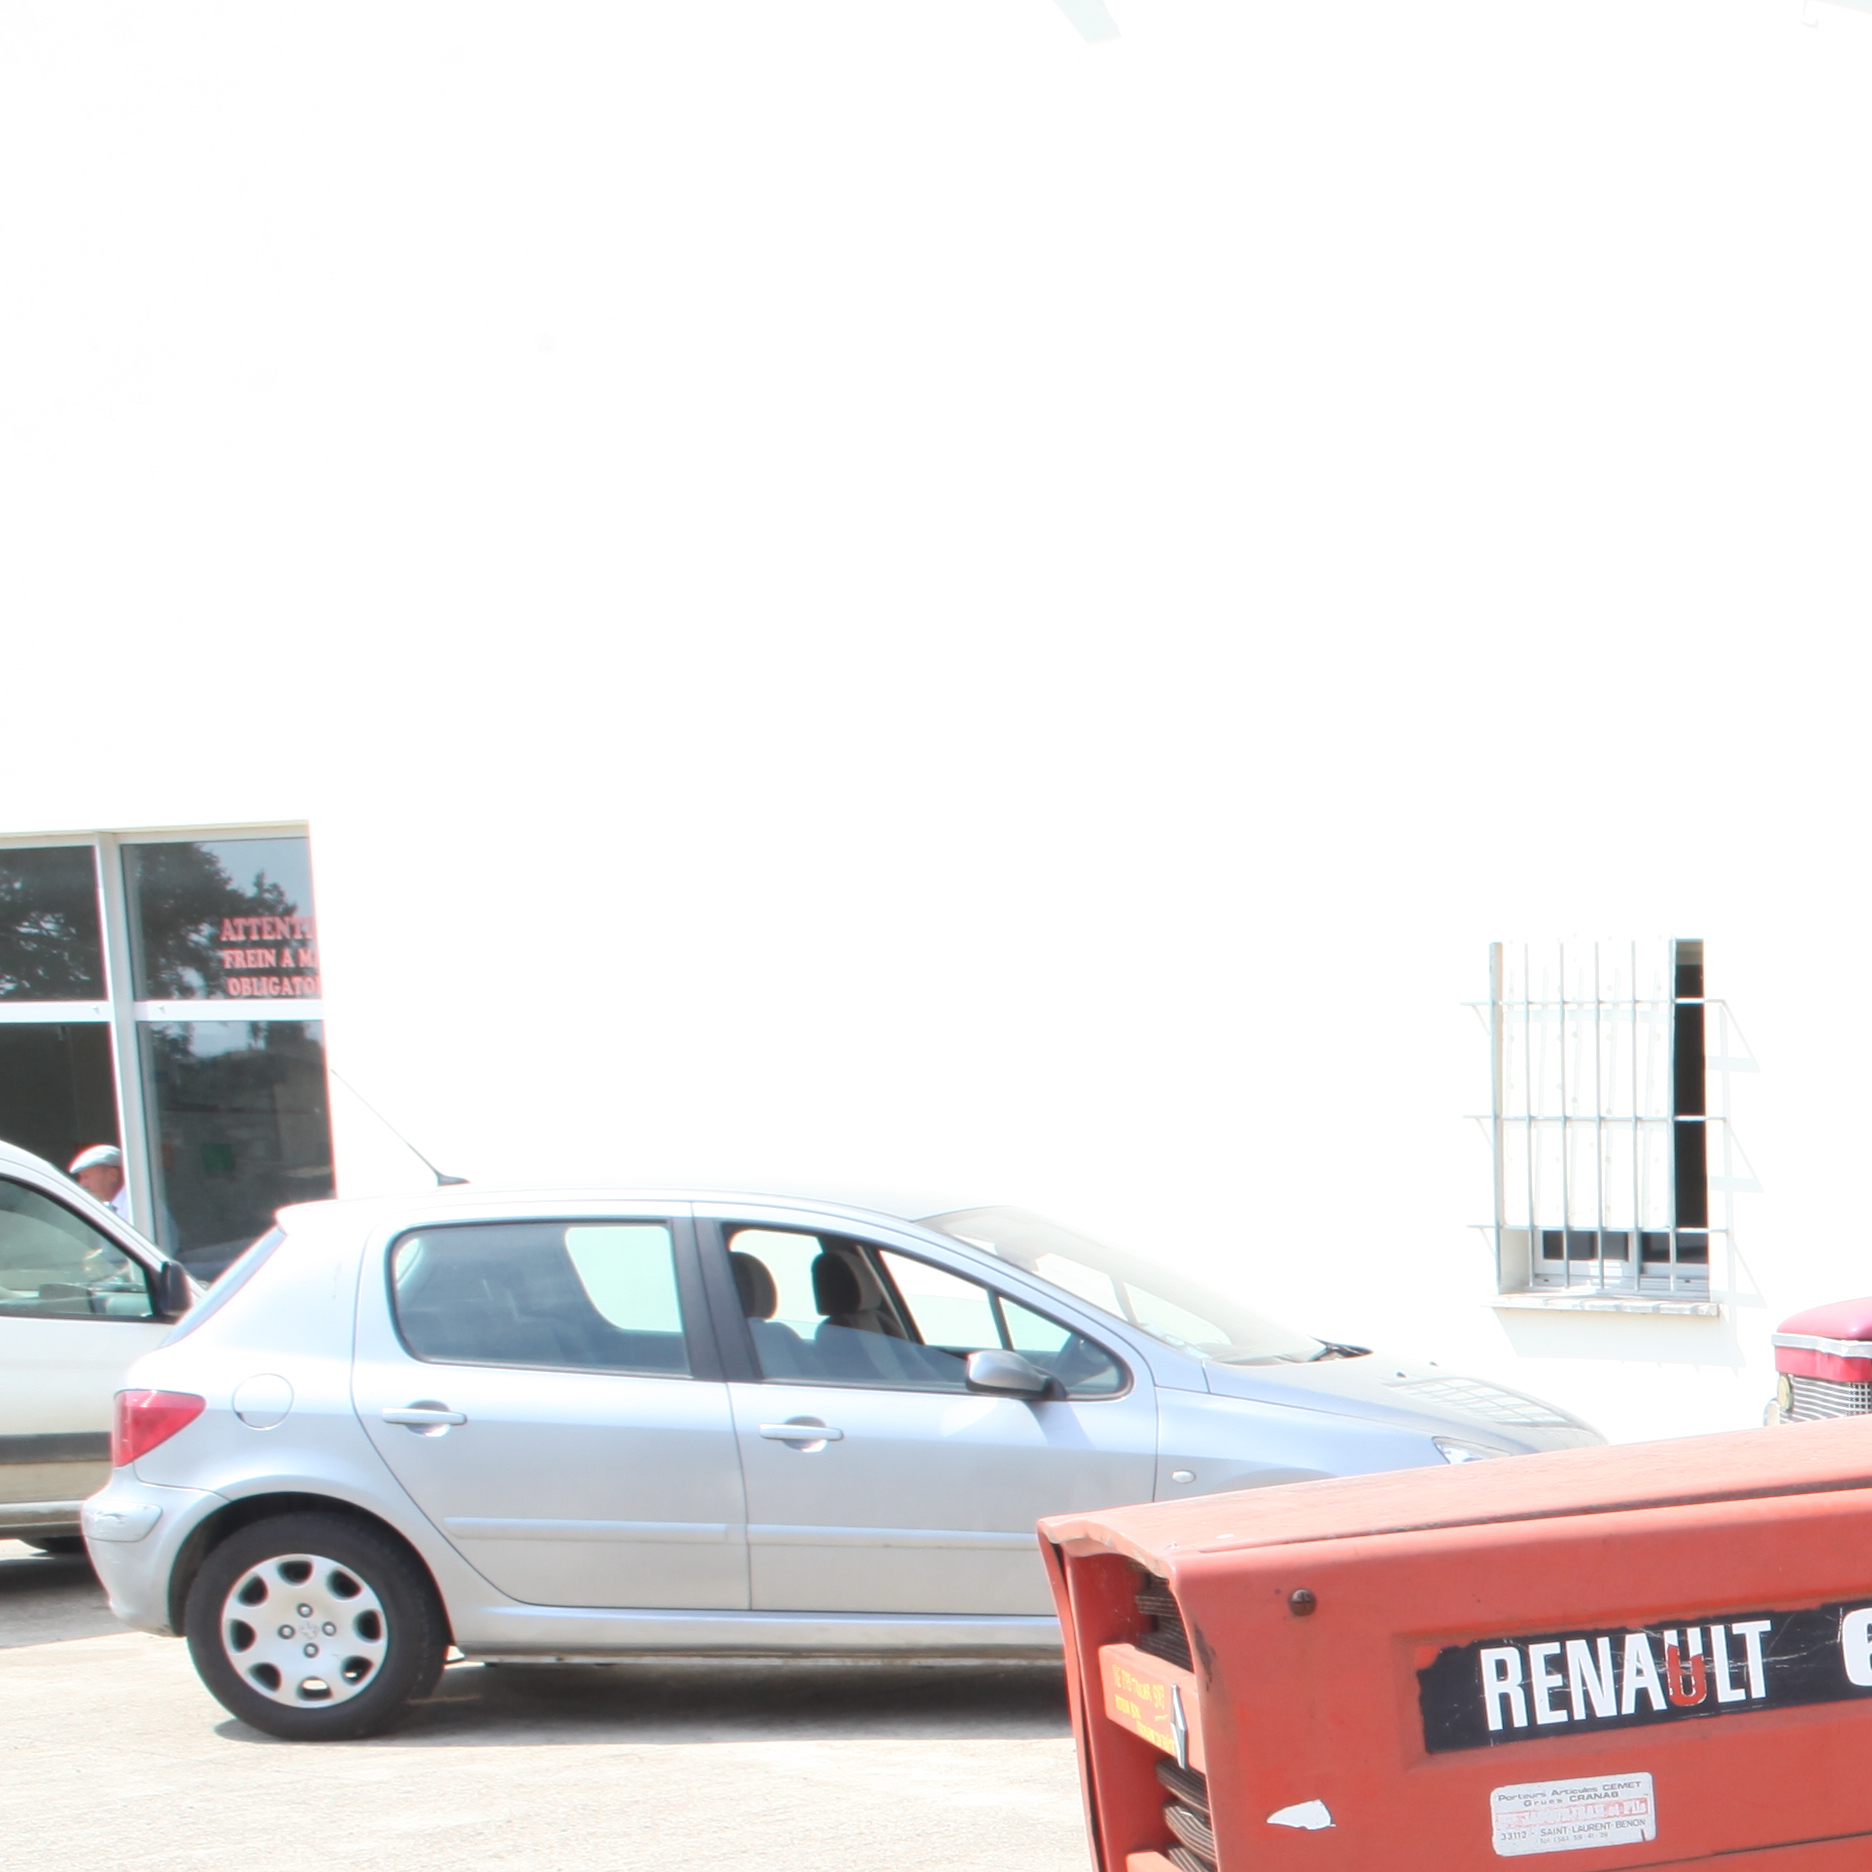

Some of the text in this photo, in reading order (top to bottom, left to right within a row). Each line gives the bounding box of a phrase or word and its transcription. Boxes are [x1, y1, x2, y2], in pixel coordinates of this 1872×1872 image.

[222, 948, 277, 969] FREIN
[280, 948, 295, 968] A
[1479, 1619, 1772, 1731] RENAULT
[1498, 1790, 1547, 1802] Porteurs
[1602, 1781, 1642, 1791] CEMET
[1523, 1798, 1564, 1807] Grues
